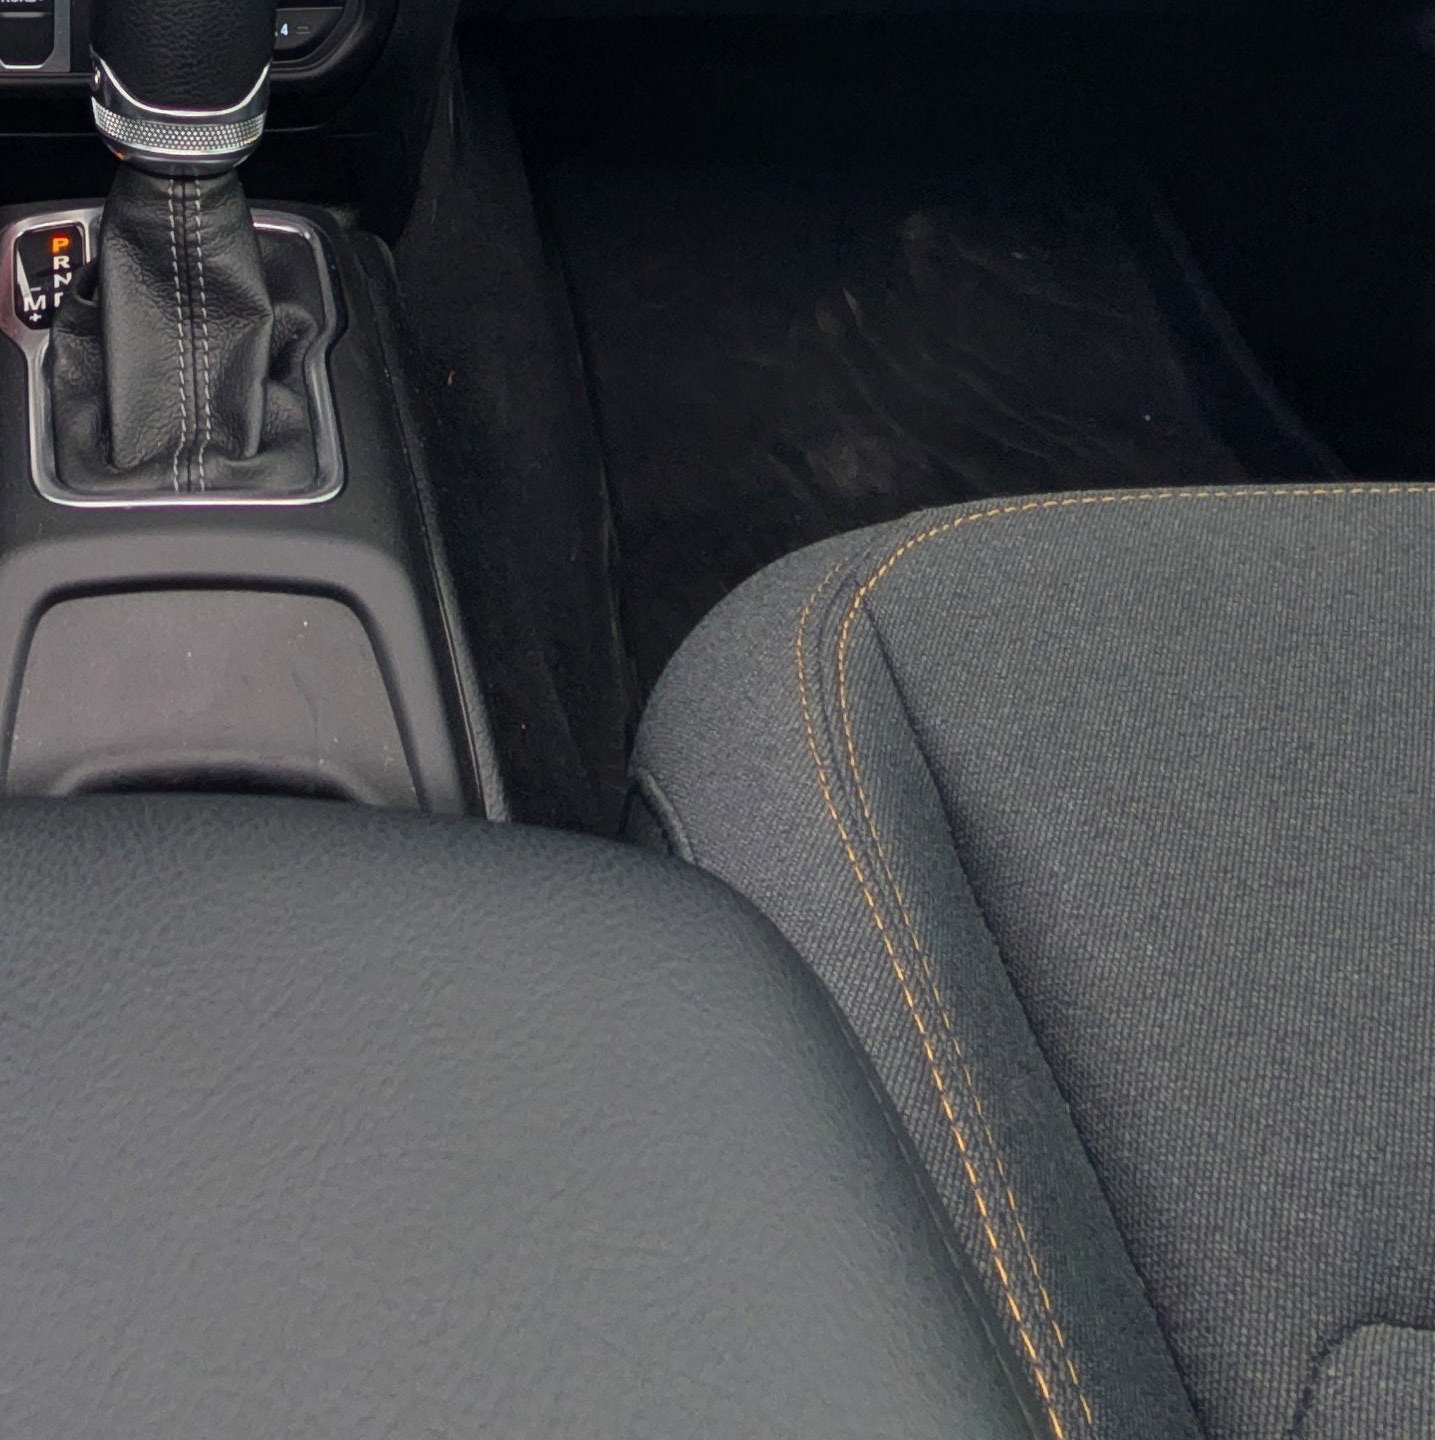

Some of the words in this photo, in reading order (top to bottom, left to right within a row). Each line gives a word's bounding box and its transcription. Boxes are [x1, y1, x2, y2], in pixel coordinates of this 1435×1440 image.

[280, 23, 289, 36] 4
[52, 237, 70, 254] P
[53, 255, 71, 270] R
[53, 271, 73, 289] N
[23, 294, 47, 312] M
